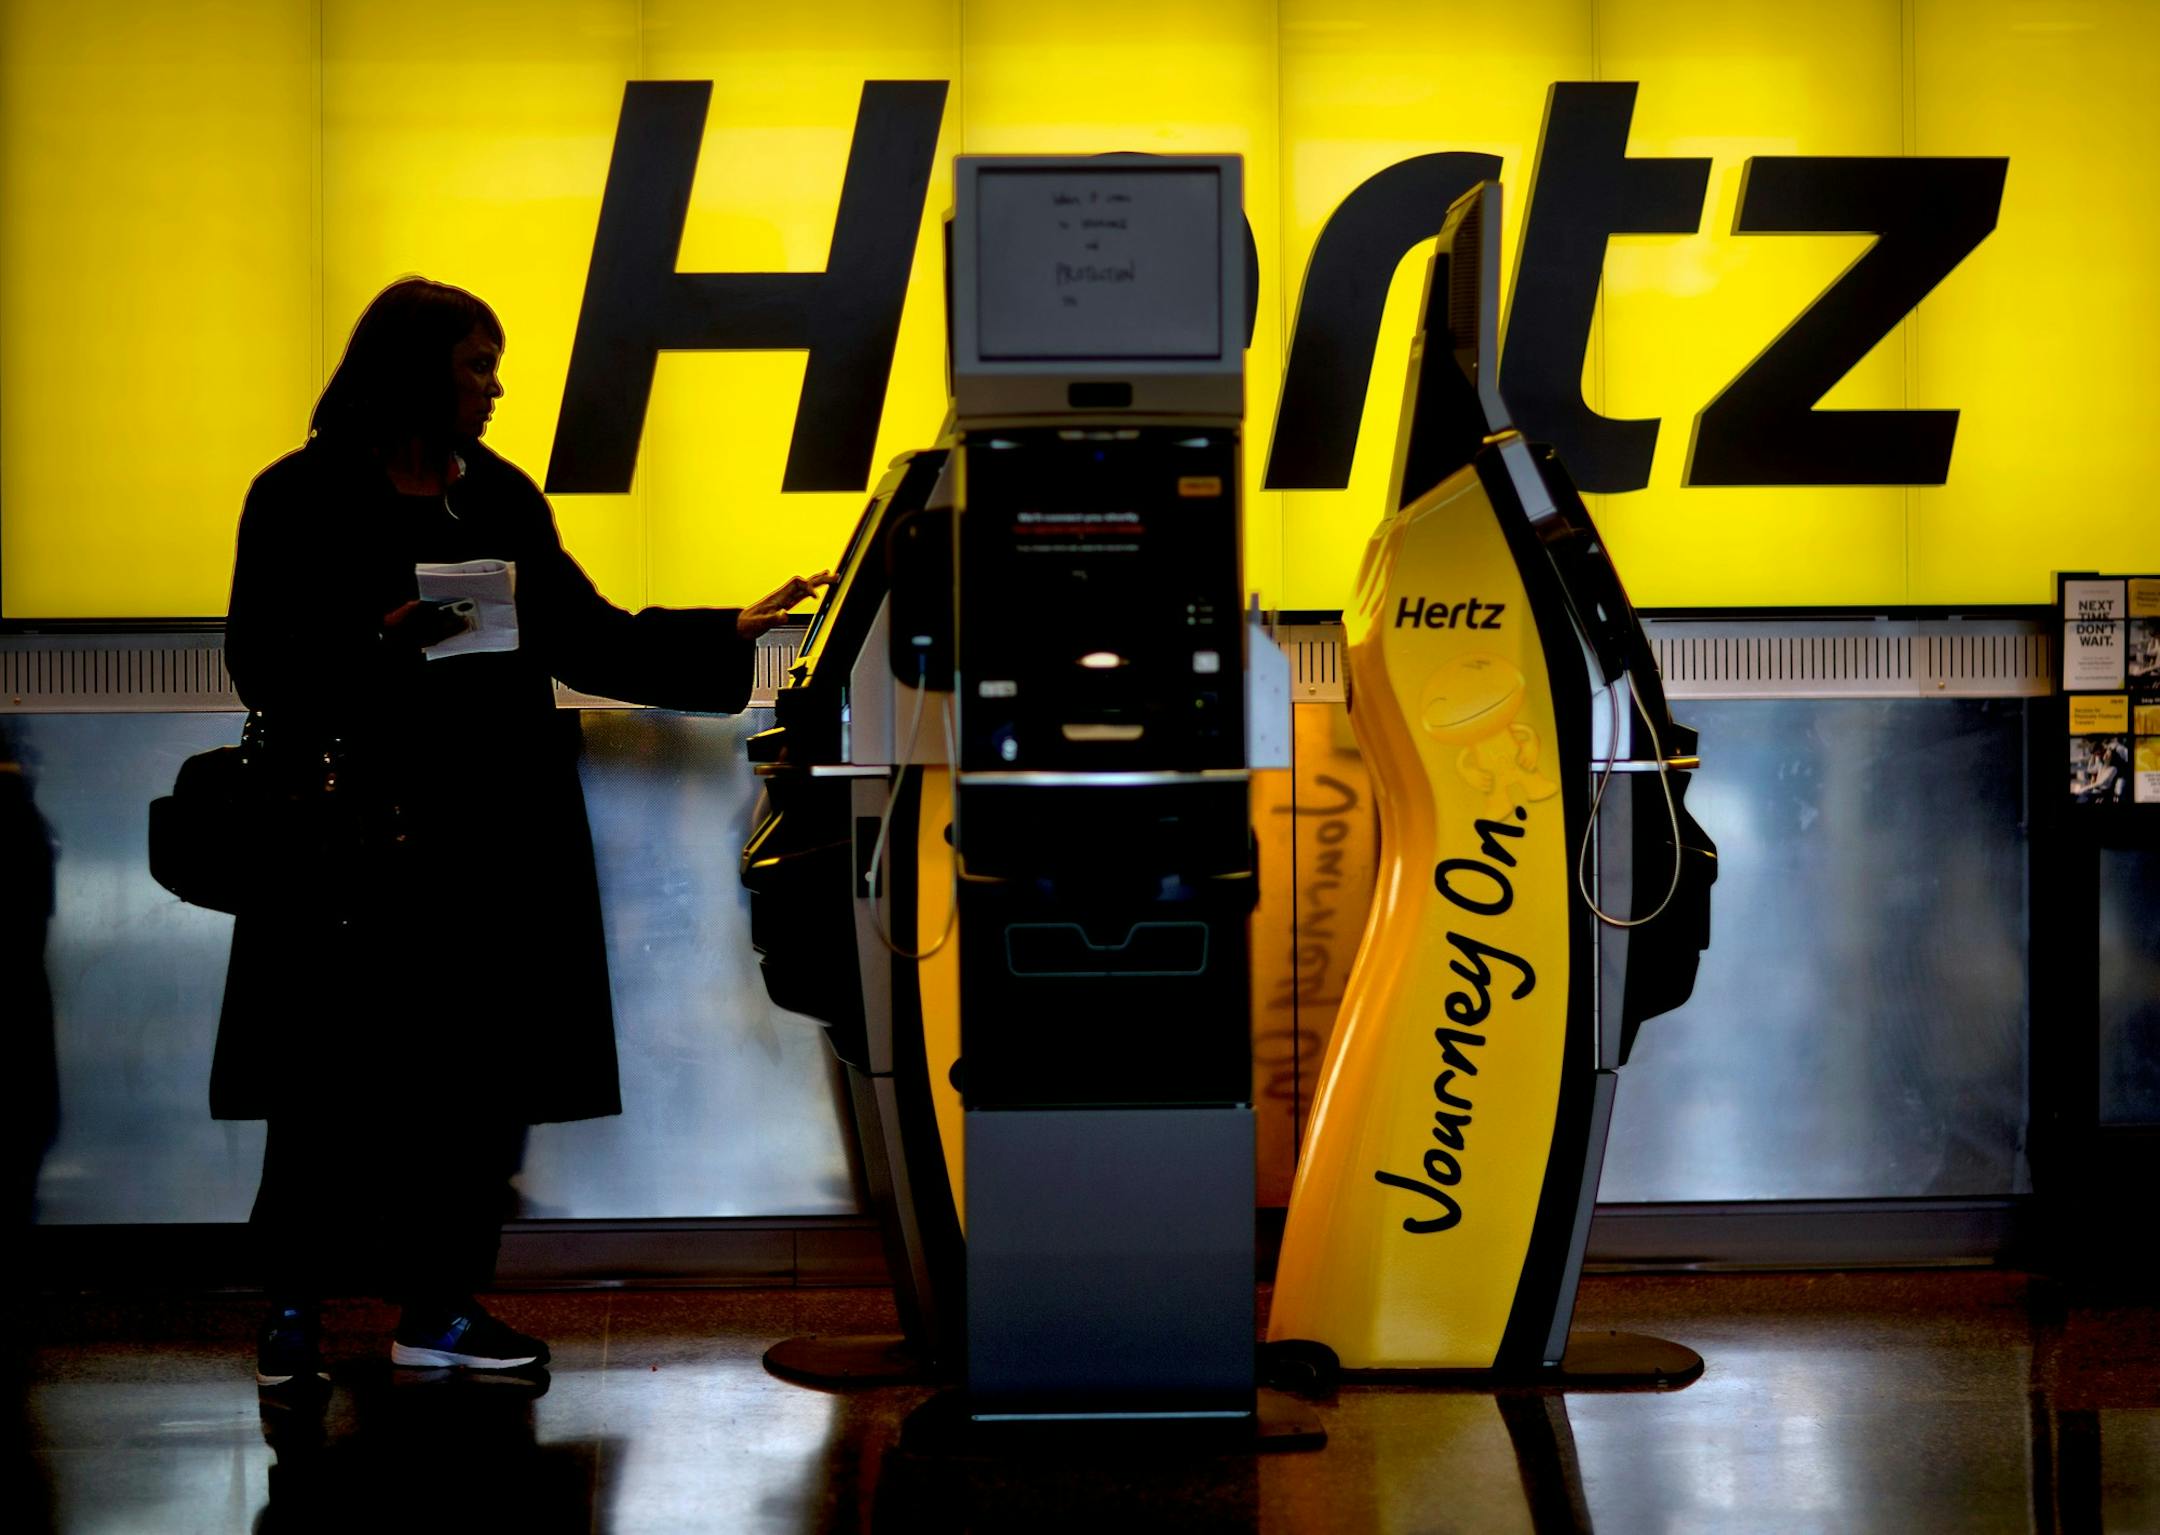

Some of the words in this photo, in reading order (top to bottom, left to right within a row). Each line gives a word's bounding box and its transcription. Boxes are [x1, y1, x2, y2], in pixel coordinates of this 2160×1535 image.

[544, 79, 2010, 494] Hrtz
[1395, 596, 1506, 631] Hertz
[2078, 600, 2114, 611] NEXT
[2076, 623, 2116, 635] DON'T
[2079, 635, 2113, 647] WAIT.
[1435, 805, 1528, 916] On.
[1374, 932, 1537, 1236] Journey
